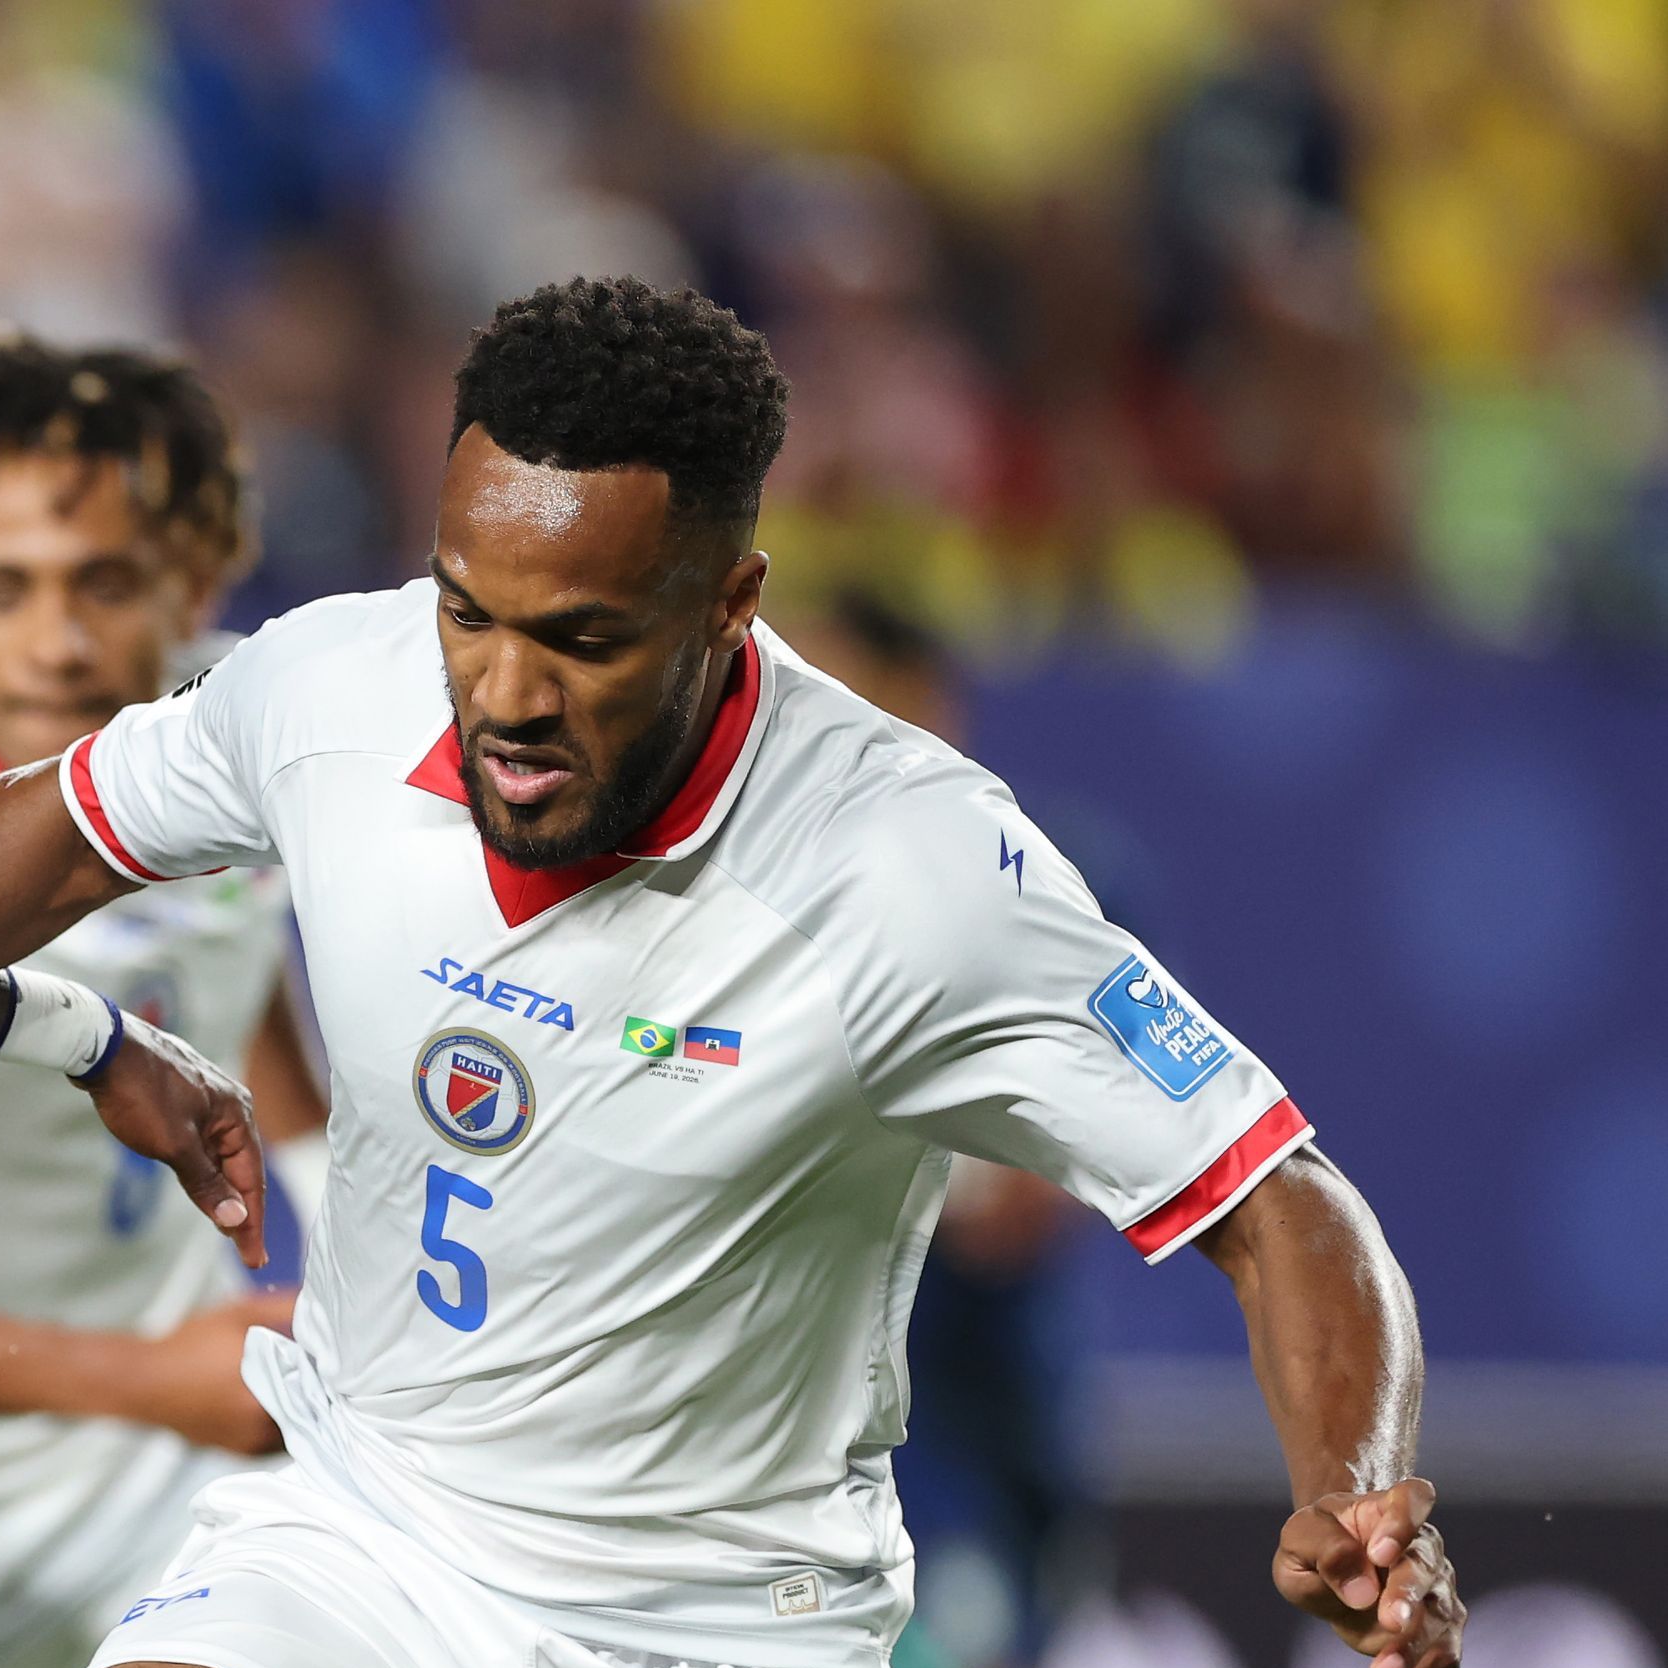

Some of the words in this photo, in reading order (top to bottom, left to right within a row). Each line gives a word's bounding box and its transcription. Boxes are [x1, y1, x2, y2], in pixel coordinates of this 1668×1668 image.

[420, 957, 575, 1031] SAETA
[1165, 1018, 1212, 1062] PEAC
[1191, 1040, 1222, 1066] FIFA
[457, 1056, 497, 1079] HAITI
[649, 1062, 672, 1070] BRAZIL
[675, 1065, 684, 1073] VS
[416, 1164, 494, 1333] 5
